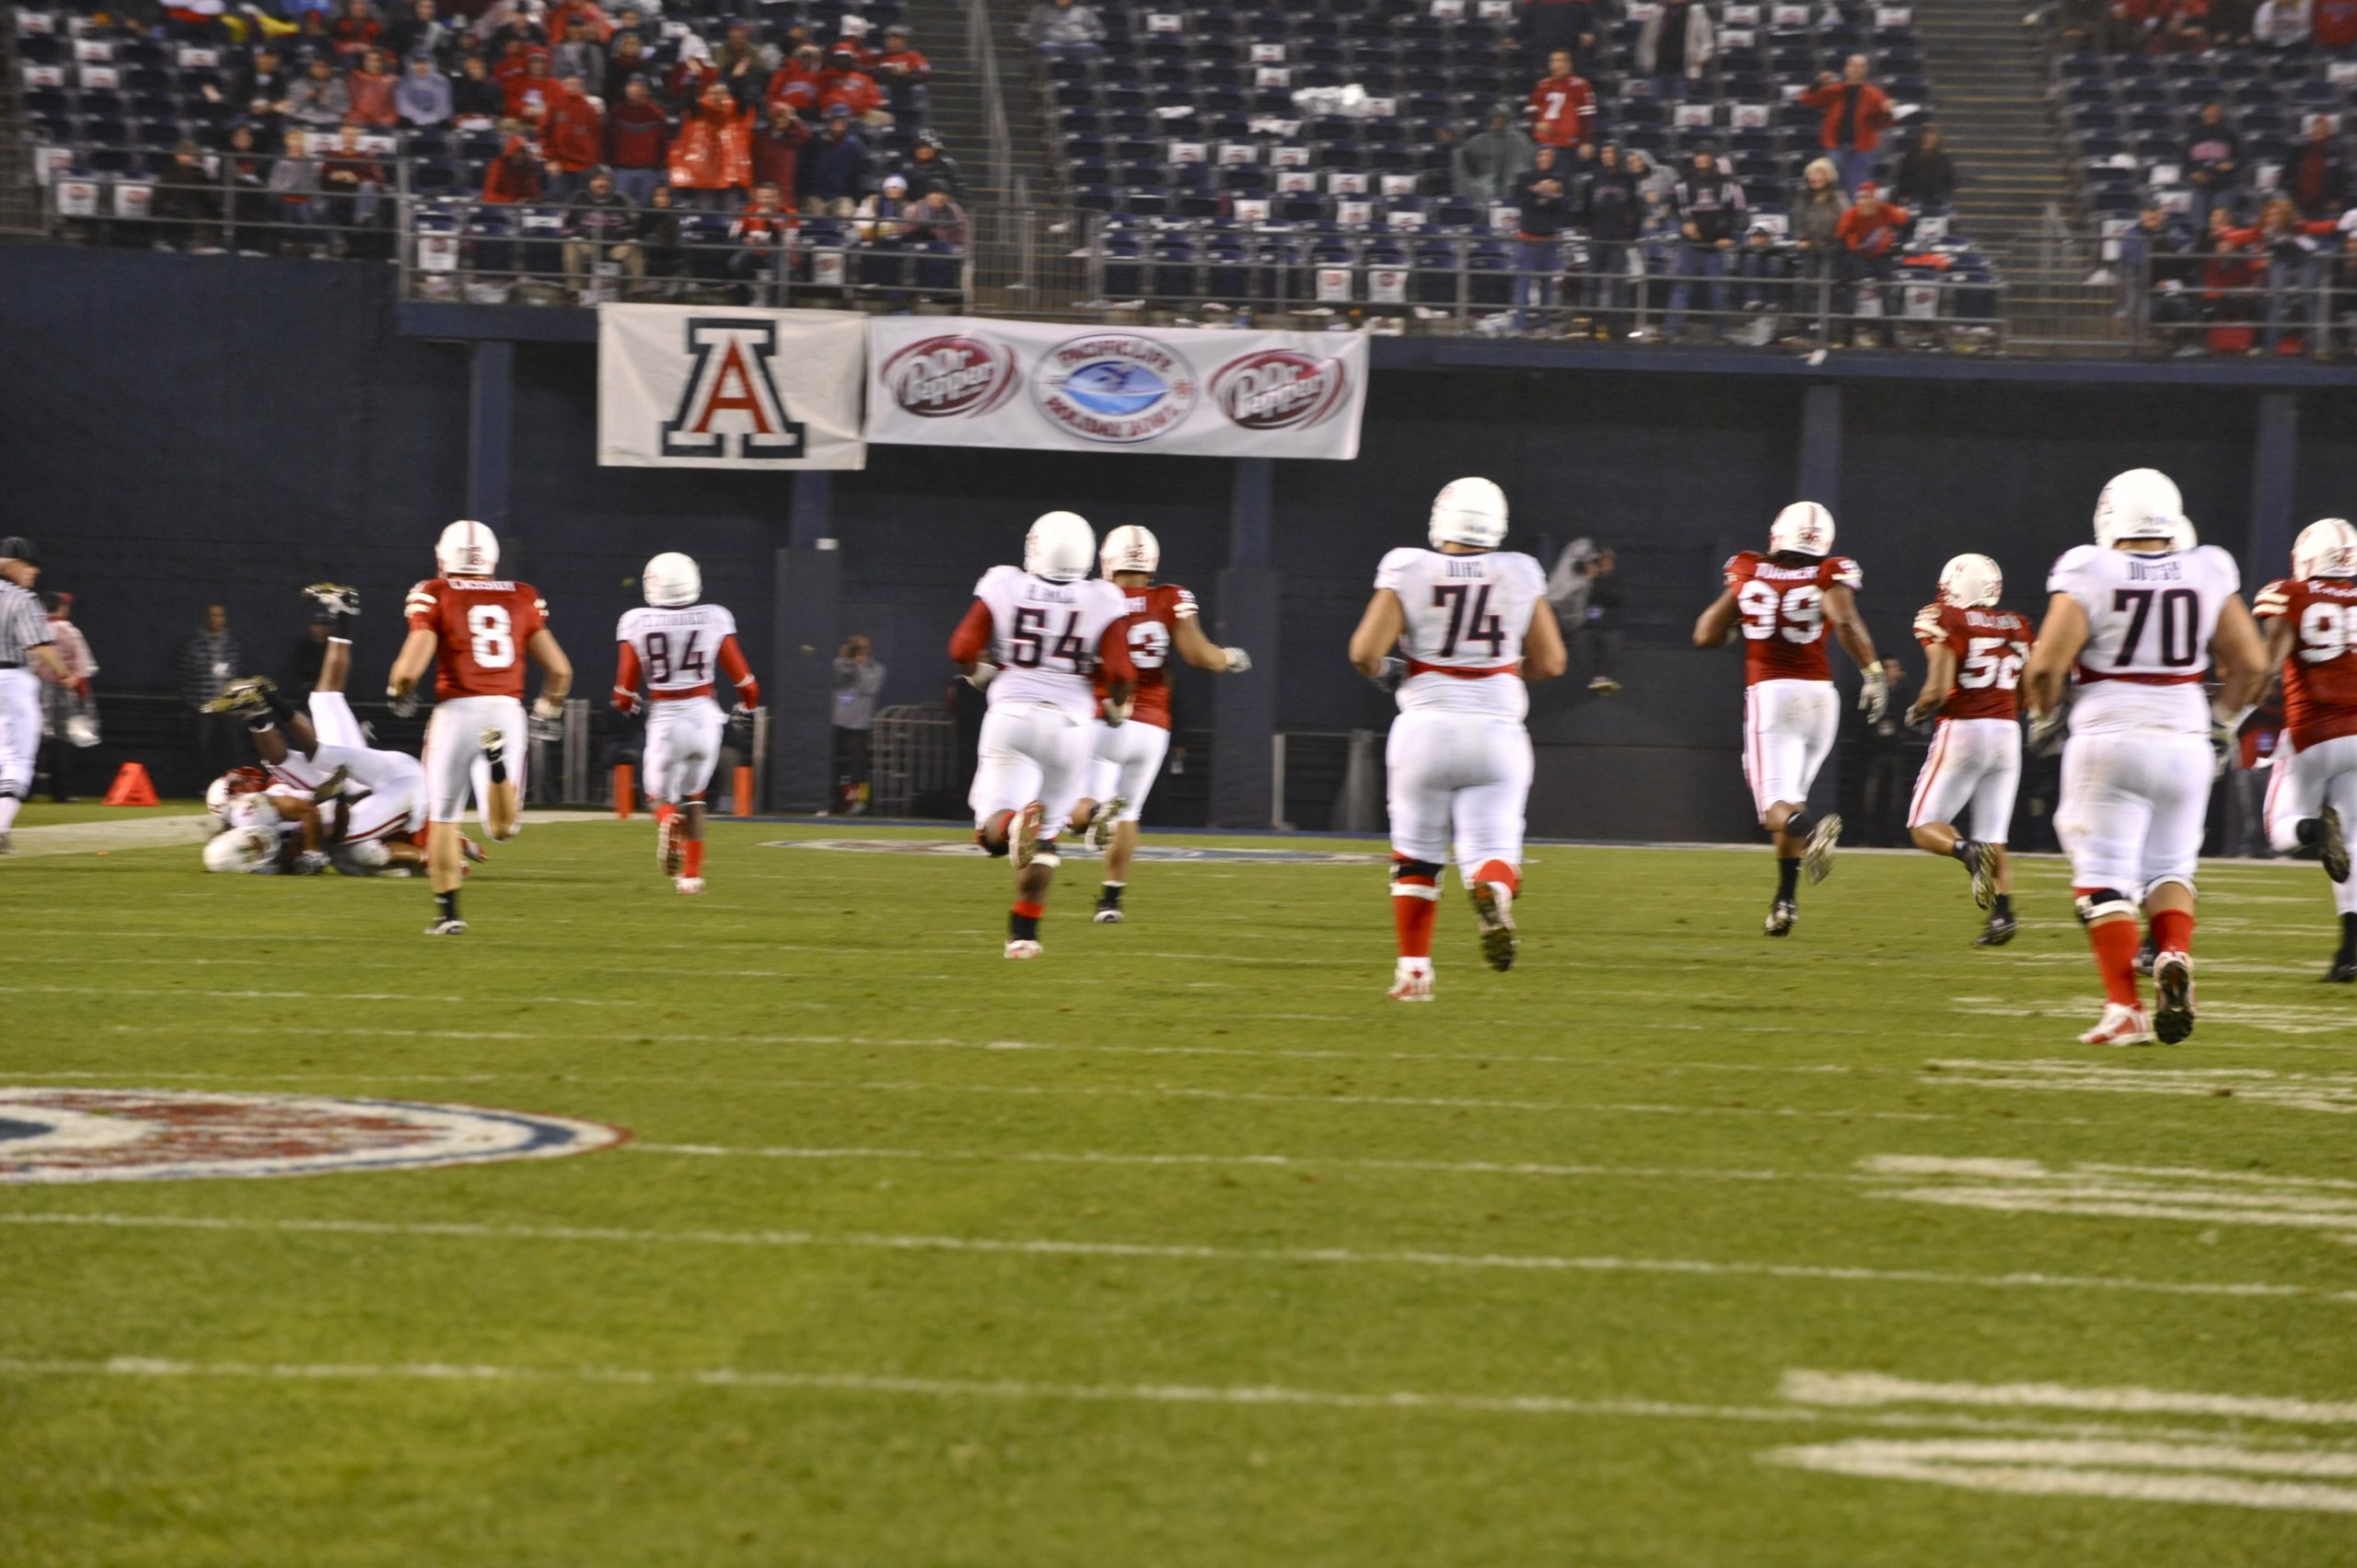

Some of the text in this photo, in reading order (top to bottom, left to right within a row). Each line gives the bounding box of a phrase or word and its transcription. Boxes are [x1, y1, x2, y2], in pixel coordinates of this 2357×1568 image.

[1543, 92, 1566, 120] 7
[660, 318, 806, 459] A
[904, 355, 995, 405] Pepper
[1234, 368, 1325, 419] Pepper
[467, 605, 516, 668] 8
[1013, 607, 1085, 673] 54
[1433, 585, 1505, 657] 74
[1736, 580, 1825, 644] 99
[2112, 588, 2200, 668] 70
[2298, 601, 2357, 663] 9
[646, 630, 706, 683] 84
[1957, 636, 2031, 690] 52
